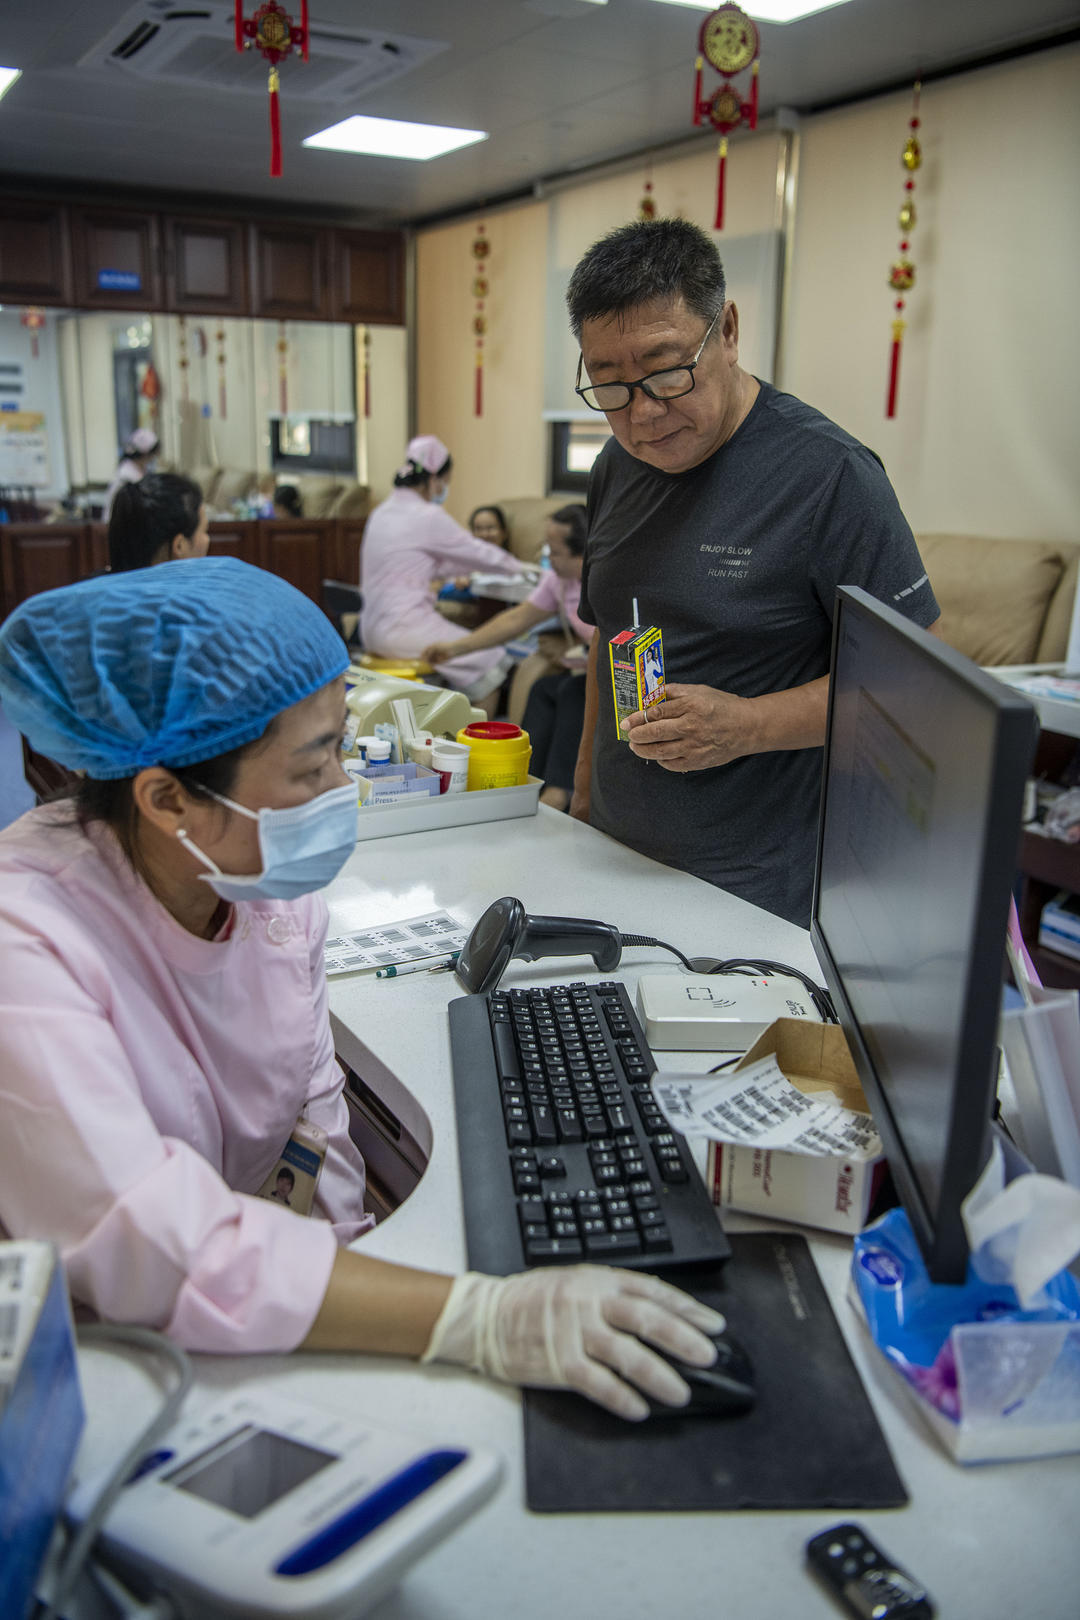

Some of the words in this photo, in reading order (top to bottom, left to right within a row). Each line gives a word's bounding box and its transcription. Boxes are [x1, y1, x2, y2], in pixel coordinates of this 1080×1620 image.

[699, 544, 727, 553] ENJOY
[727, 546, 753, 556] SLOW
[707, 568, 727, 577] RUN
[727, 570, 749, 579] FAST
